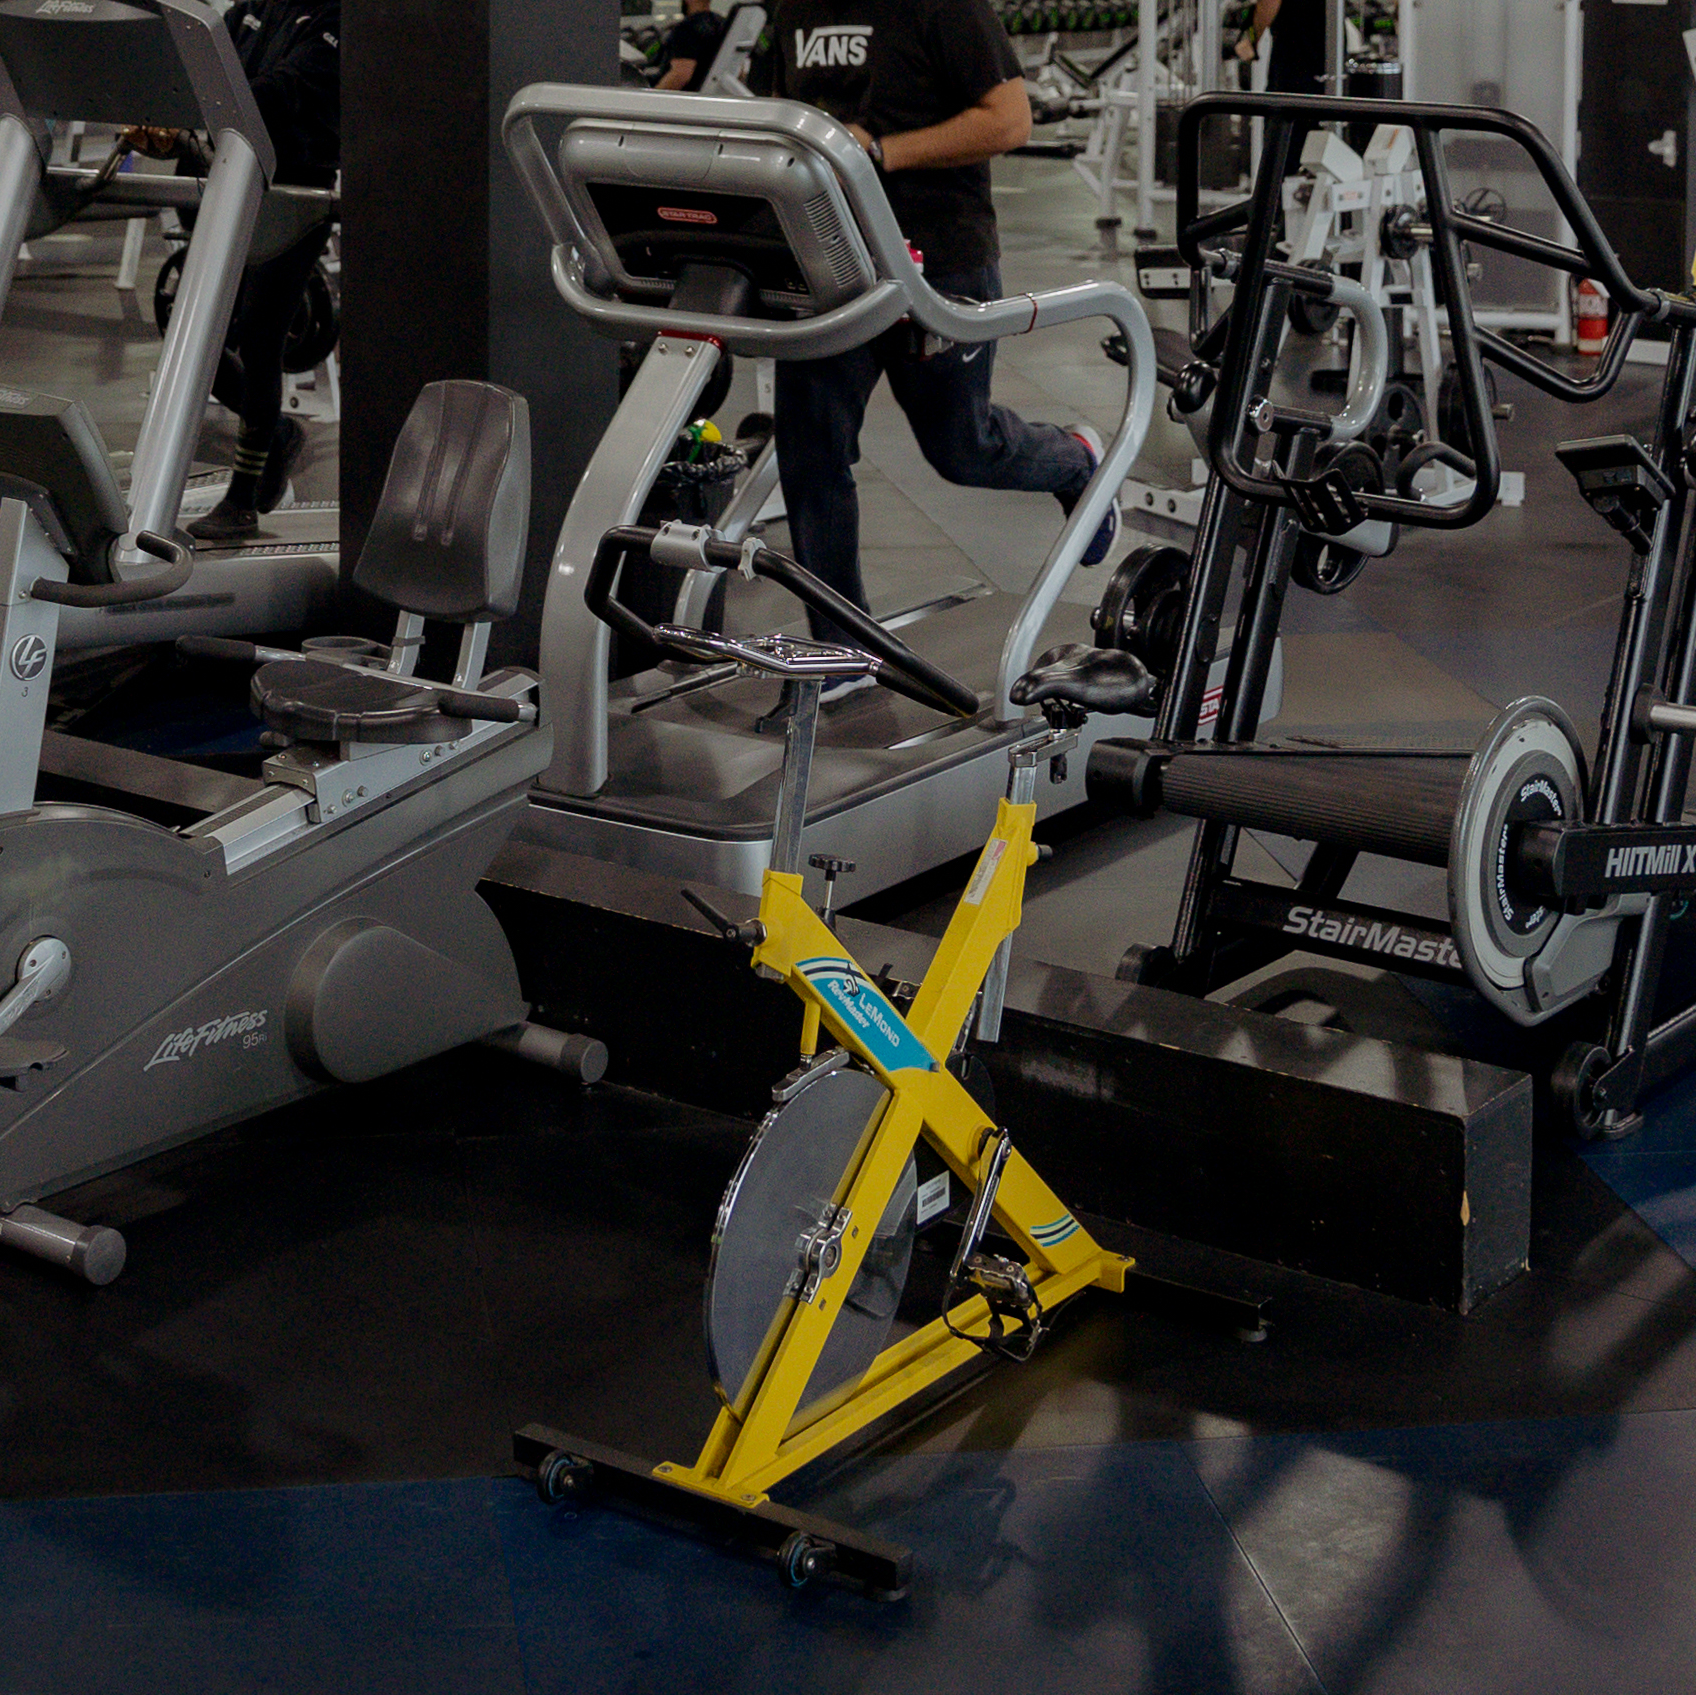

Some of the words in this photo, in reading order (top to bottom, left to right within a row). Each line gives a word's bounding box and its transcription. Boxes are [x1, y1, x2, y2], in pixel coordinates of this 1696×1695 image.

[795, 25, 874, 69] VANS
[1282, 905, 1463, 970] StairMaste
[826, 978, 871, 1028] RevMaster
